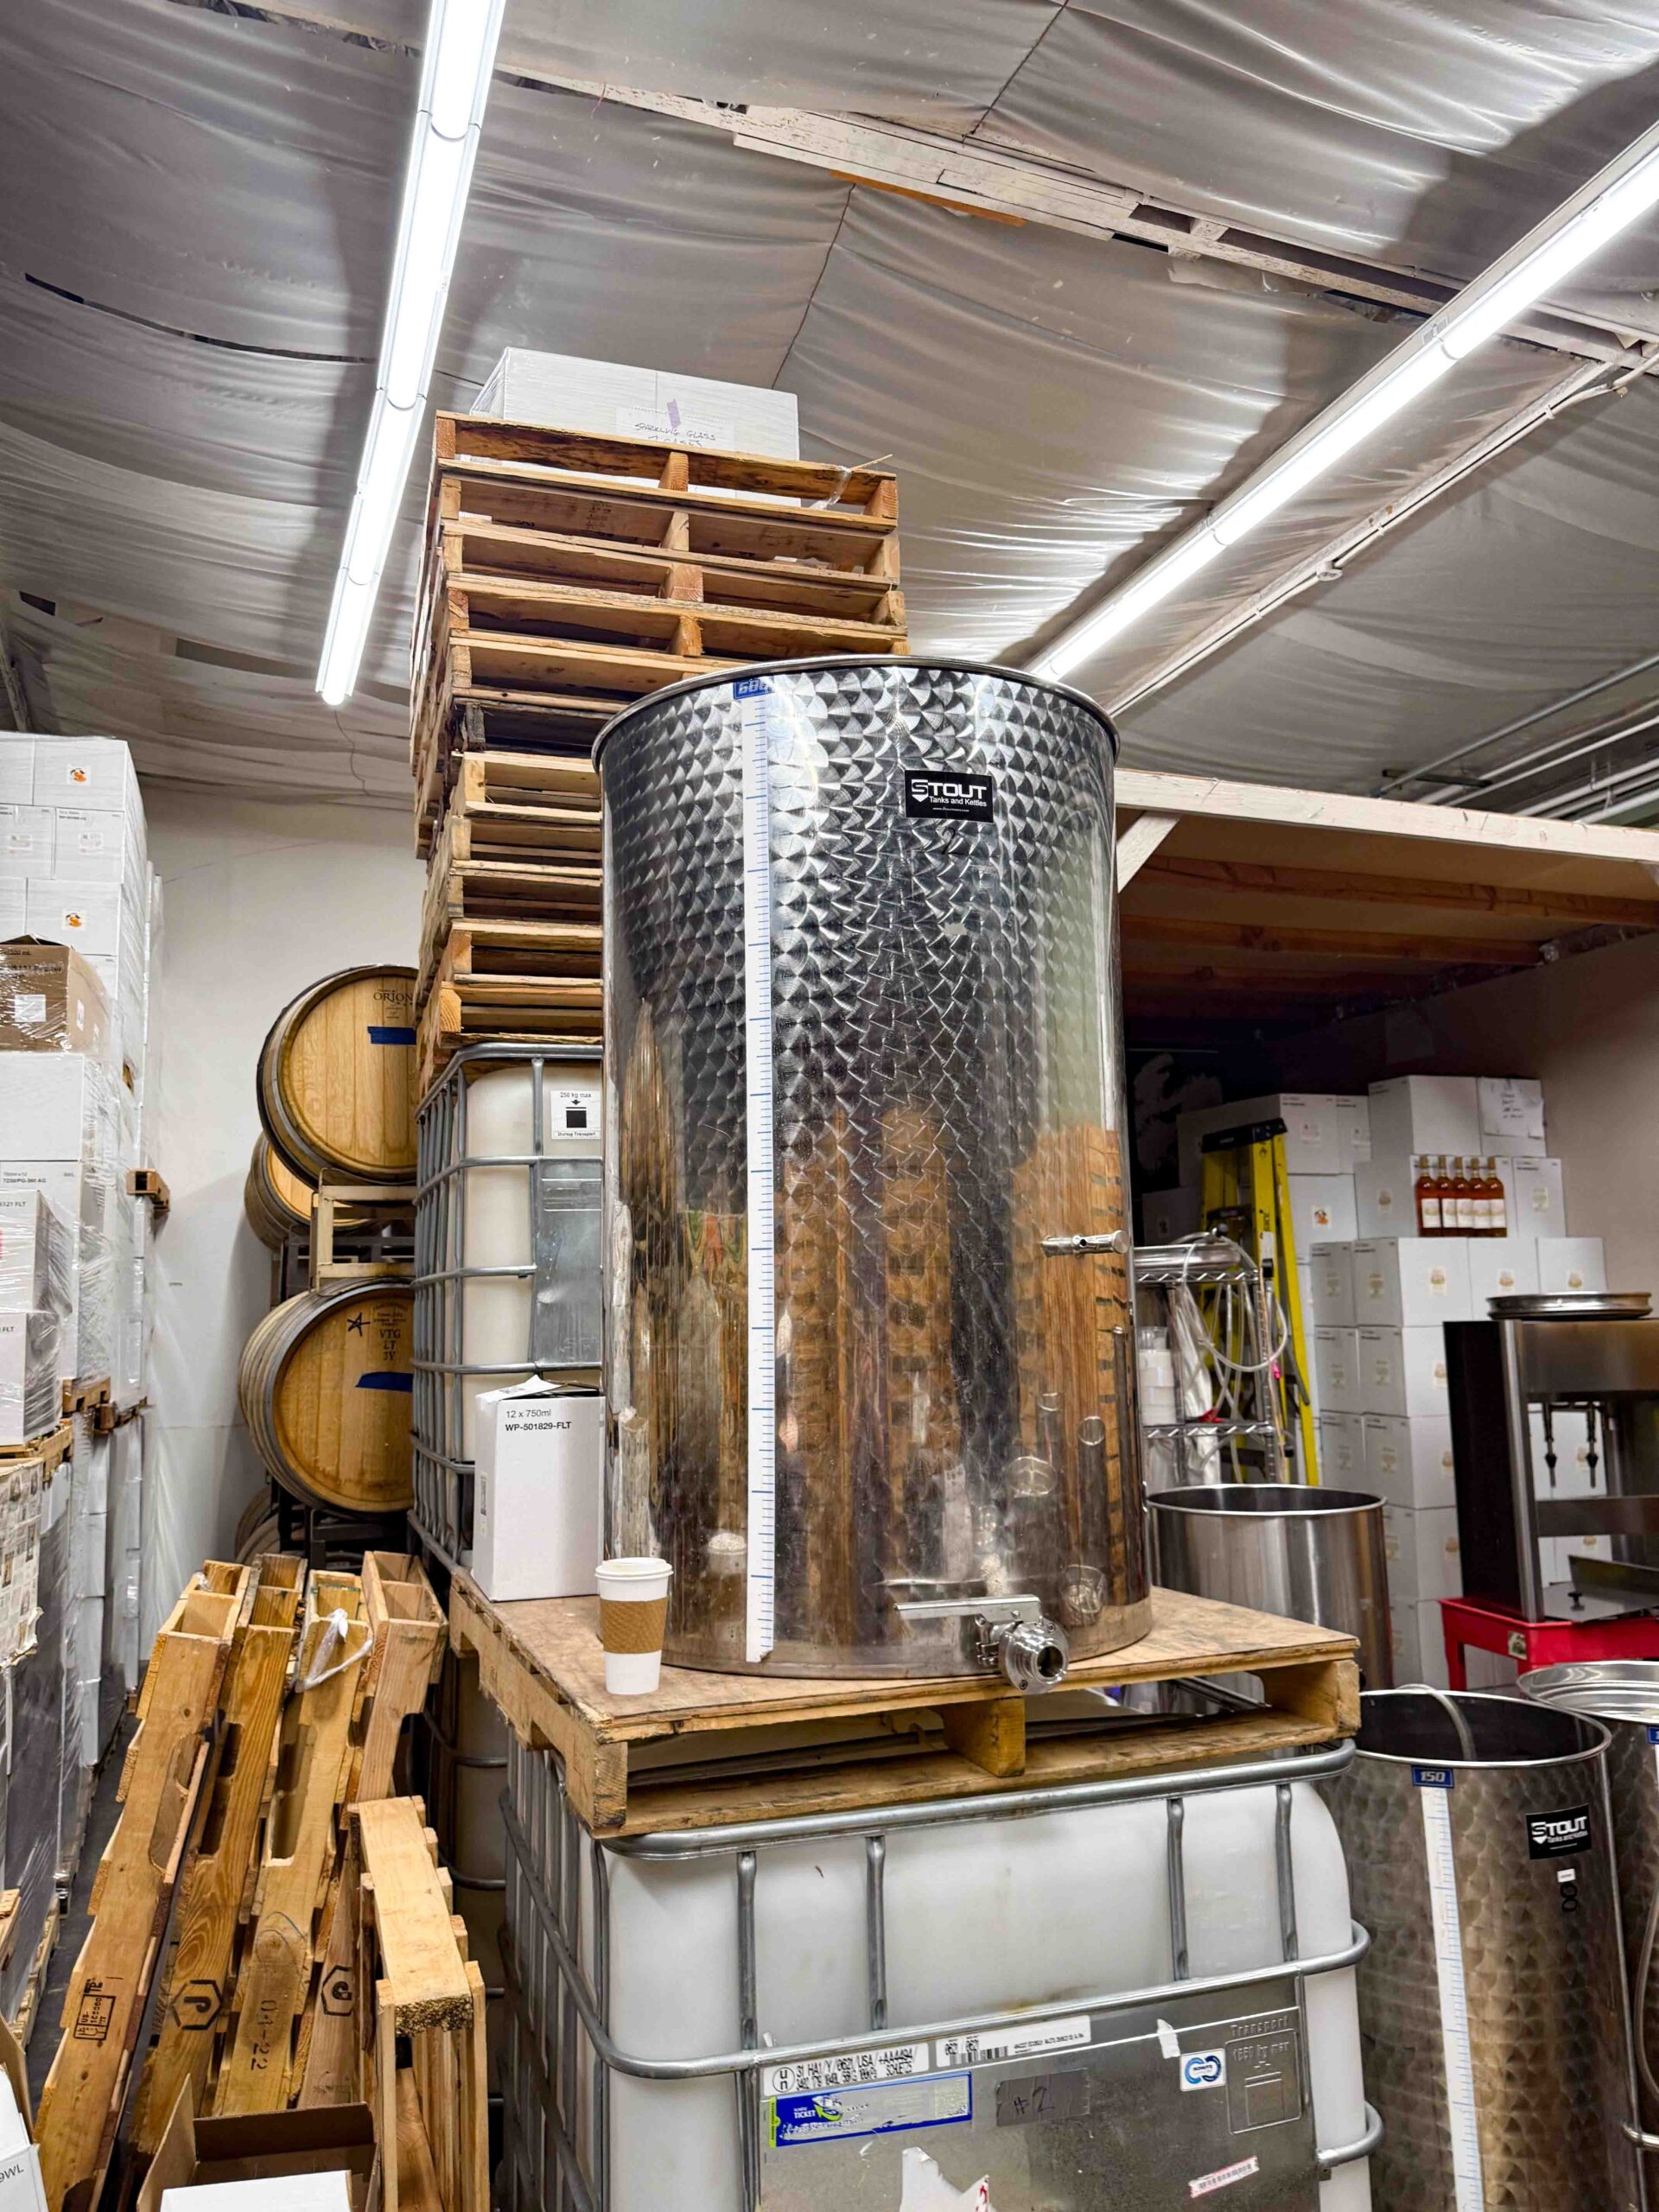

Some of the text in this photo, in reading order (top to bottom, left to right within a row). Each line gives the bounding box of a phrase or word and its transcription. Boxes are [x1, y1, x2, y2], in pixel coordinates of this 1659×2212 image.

[686, 430, 716, 442] GLASS
[911, 779, 987, 803] STOUT
[950, 797, 963, 805] and
[964, 798, 988, 807] Kettles
[373, 992, 413, 1003] ORION
[506, 1410, 517, 1419] 12
[525, 1408, 552, 1418] 750ml
[505, 1421, 573, 1432] WP-501829-FLT
[1420, 1771, 1446, 1783] 150
[1530, 1815, 1588, 1844] STOUT
[793, 2109, 816, 2120] TICKET
